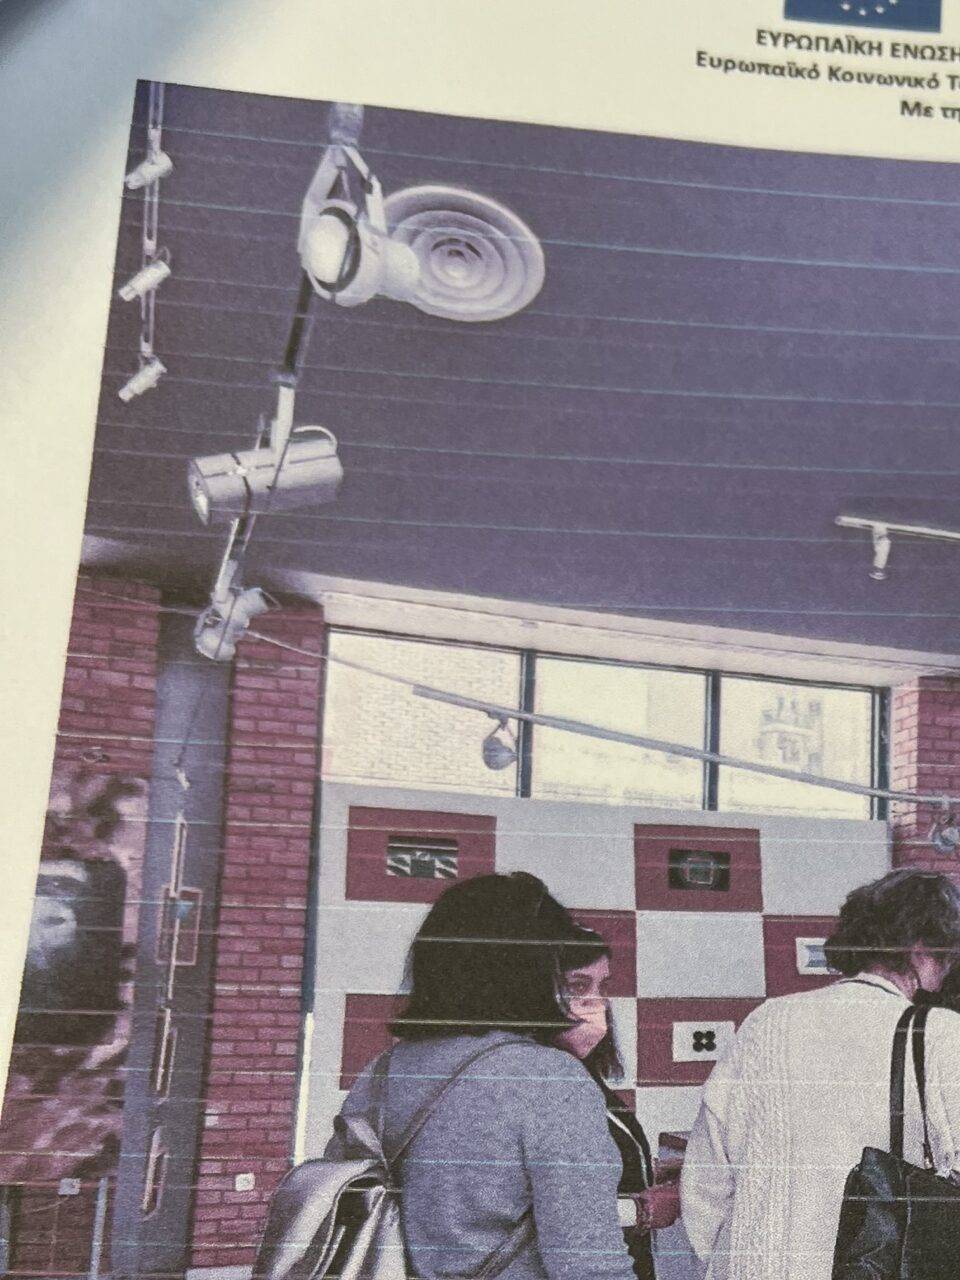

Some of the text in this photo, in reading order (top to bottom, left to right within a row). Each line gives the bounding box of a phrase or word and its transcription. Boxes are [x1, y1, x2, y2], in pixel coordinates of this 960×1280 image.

[755, 28, 883, 57] ΕΥΡΩΠΑΪΚΗ
[695, 49, 821, 80] Ευρωπαϊκό
[827, 65, 940, 90] Κοινωνικό
[900, 100, 934, 118] Με
